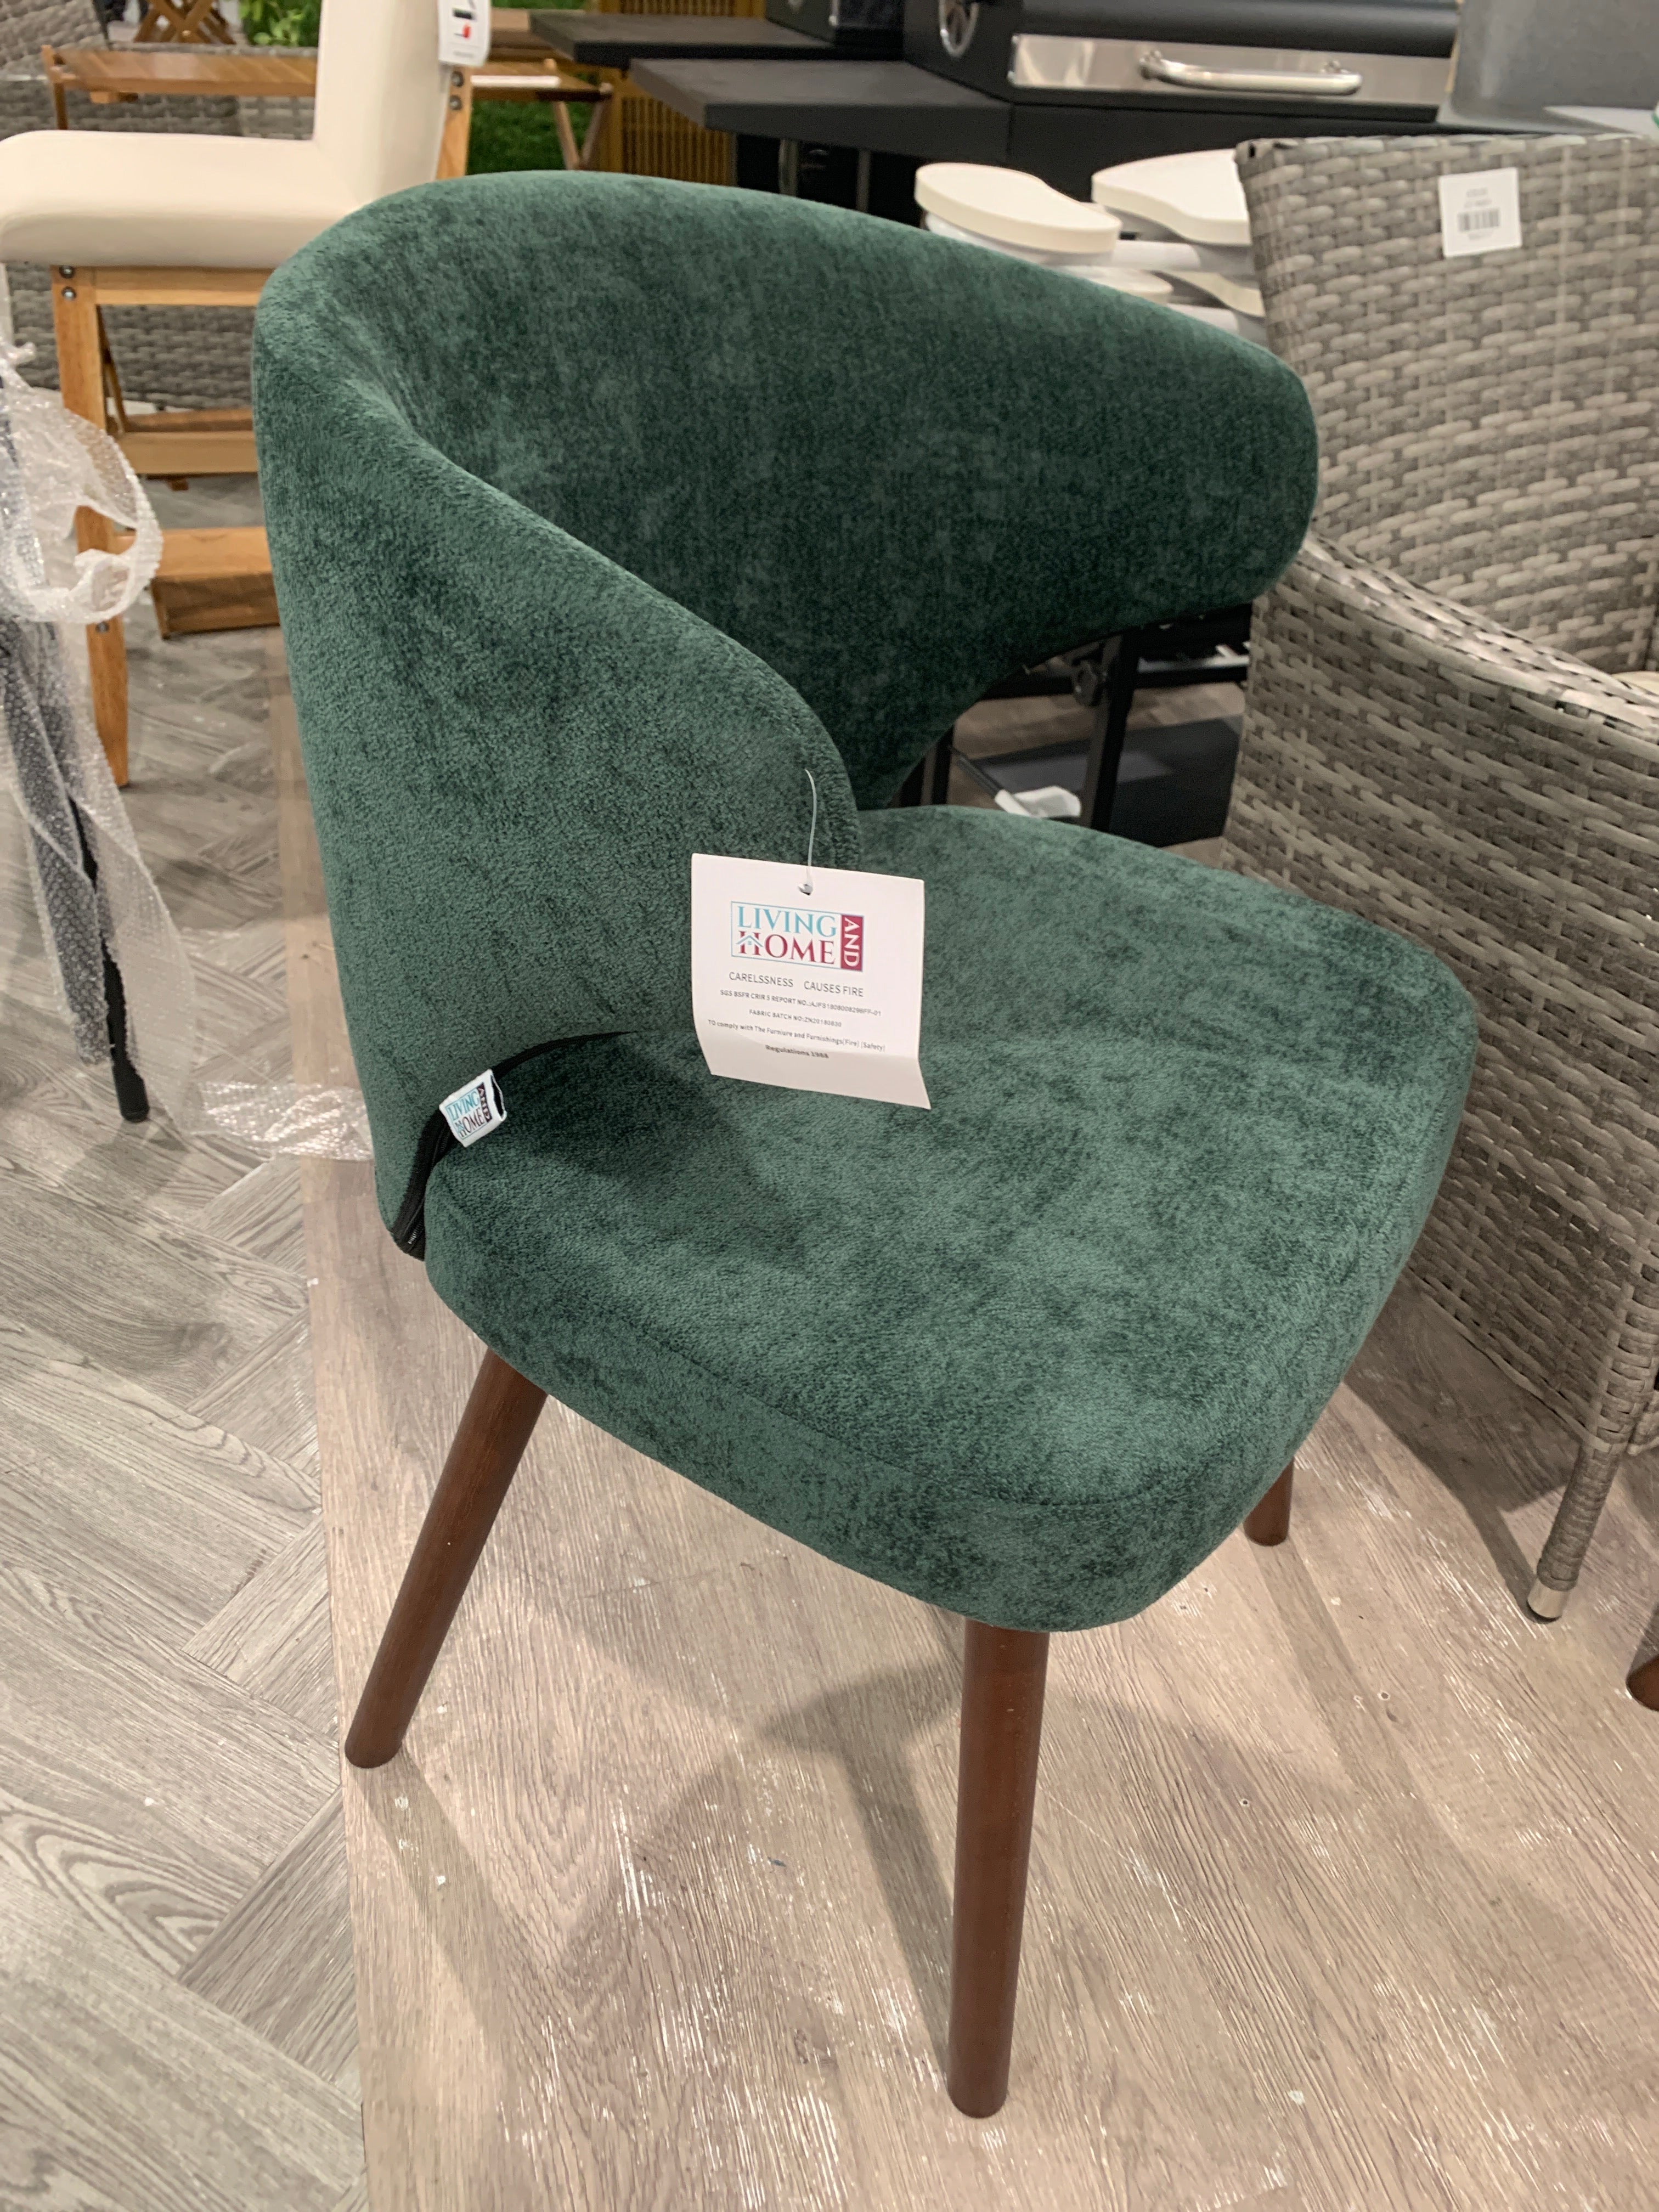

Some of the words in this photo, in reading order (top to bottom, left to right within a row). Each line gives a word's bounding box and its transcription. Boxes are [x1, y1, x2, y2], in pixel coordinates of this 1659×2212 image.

[736, 930, 836, 964] HOME
[737, 906, 837, 938] LIVING
[844, 917, 860, 967] AND
[729, 972, 794, 988] CARELSSNESS
[803, 980, 841, 994] CAUSES
[843, 986, 864, 997] FIRE
[771, 996, 796, 1004] REPORT
[749, 1009, 771, 1017] FABRIC
[716, 1022, 738, 1030] comply
[448, 1091, 479, 1120] LIVING
